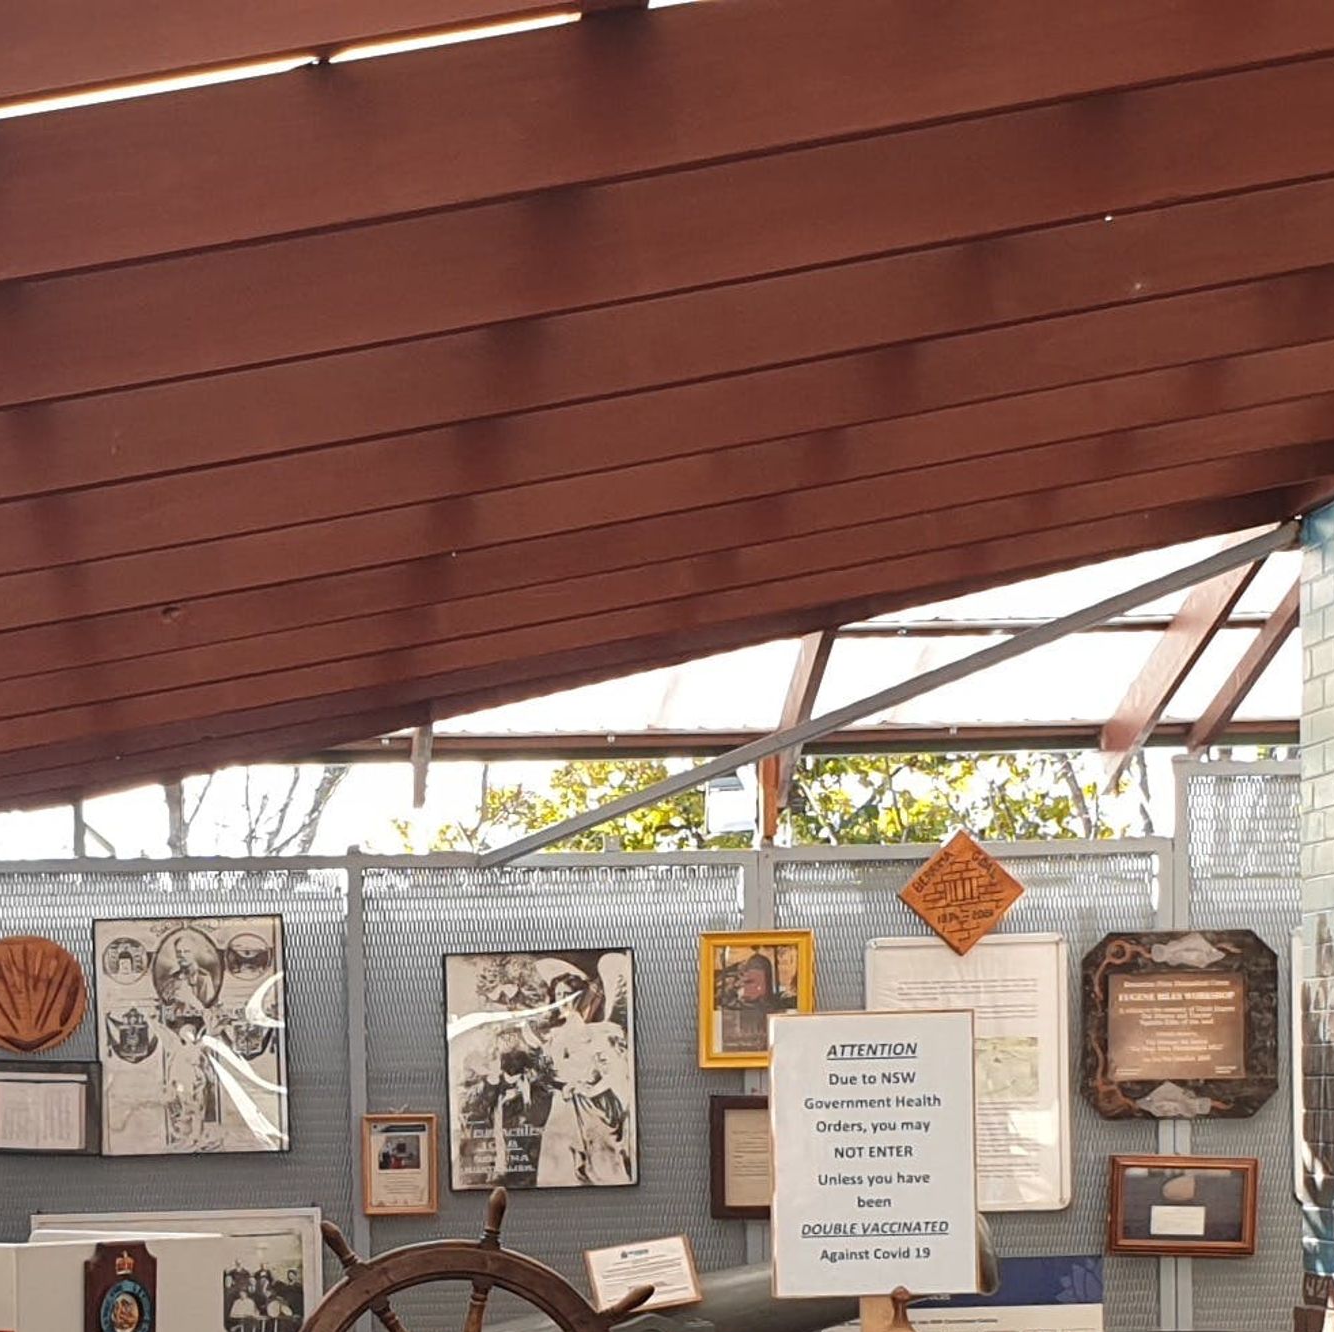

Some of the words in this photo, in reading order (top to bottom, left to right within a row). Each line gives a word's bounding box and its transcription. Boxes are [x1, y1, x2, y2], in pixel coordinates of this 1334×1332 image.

[826, 1043, 917, 1060] ATTENTION
[828, 1073, 857, 1086] Due
[862, 1073, 877, 1085] to
[881, 1071, 916, 1085] NSW
[804, 1098, 891, 1110] Government
[895, 1094, 942, 1108] Health
[816, 1120, 867, 1134] Orders,
[871, 1122, 897, 1135] you
[901, 1121, 931, 1133] may
[834, 1147, 865, 1159] NOT
[869, 1145, 914, 1158] ENTER
[818, 1173, 864, 1186] Unless
[867, 1175, 893, 1188] you
[897, 1172, 931, 1185] have
[857, 1196, 892, 1208] been
[801, 1222, 857, 1236] DOUBLE
[860, 1220, 950, 1235] VACCINATED
[820, 1248, 869, 1263] Against
[873, 1247, 910, 1260] Covid
[914, 1246, 931, 1259] 19
